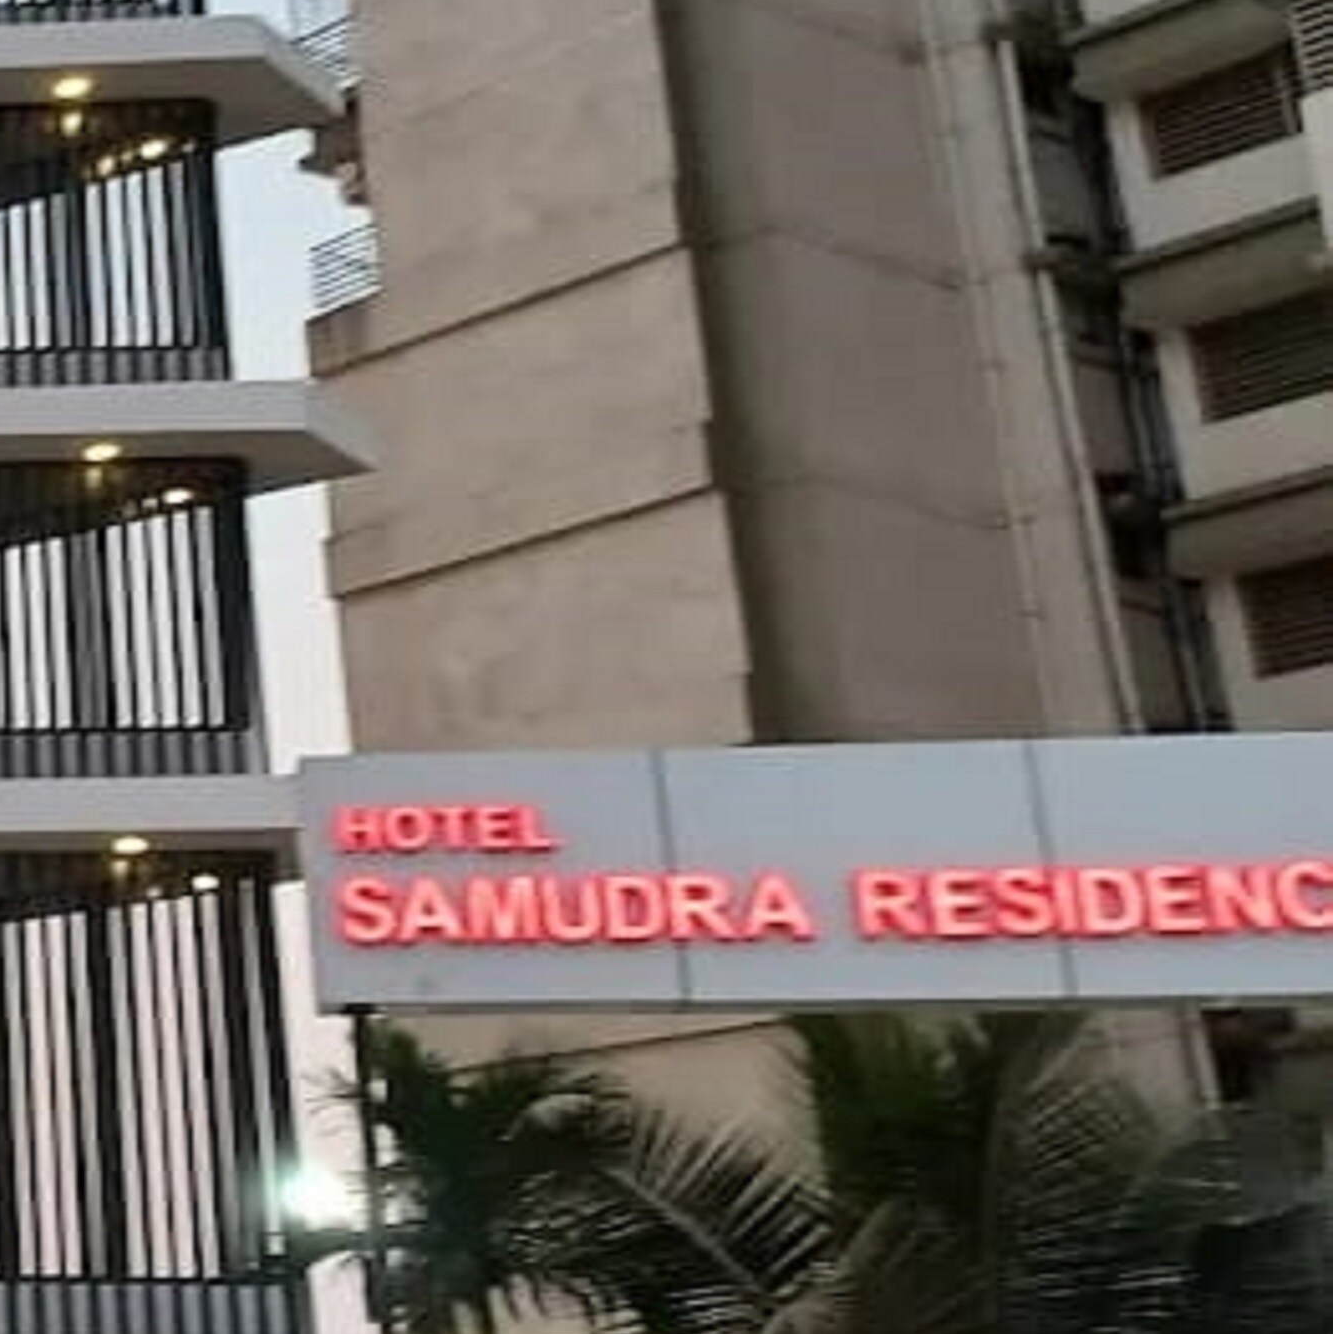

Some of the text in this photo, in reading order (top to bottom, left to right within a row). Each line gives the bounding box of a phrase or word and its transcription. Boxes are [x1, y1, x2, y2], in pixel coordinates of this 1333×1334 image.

[335, 804, 563, 854] HOTEL
[338, 859, 1333, 948] SAMUDRA RESIDENC
